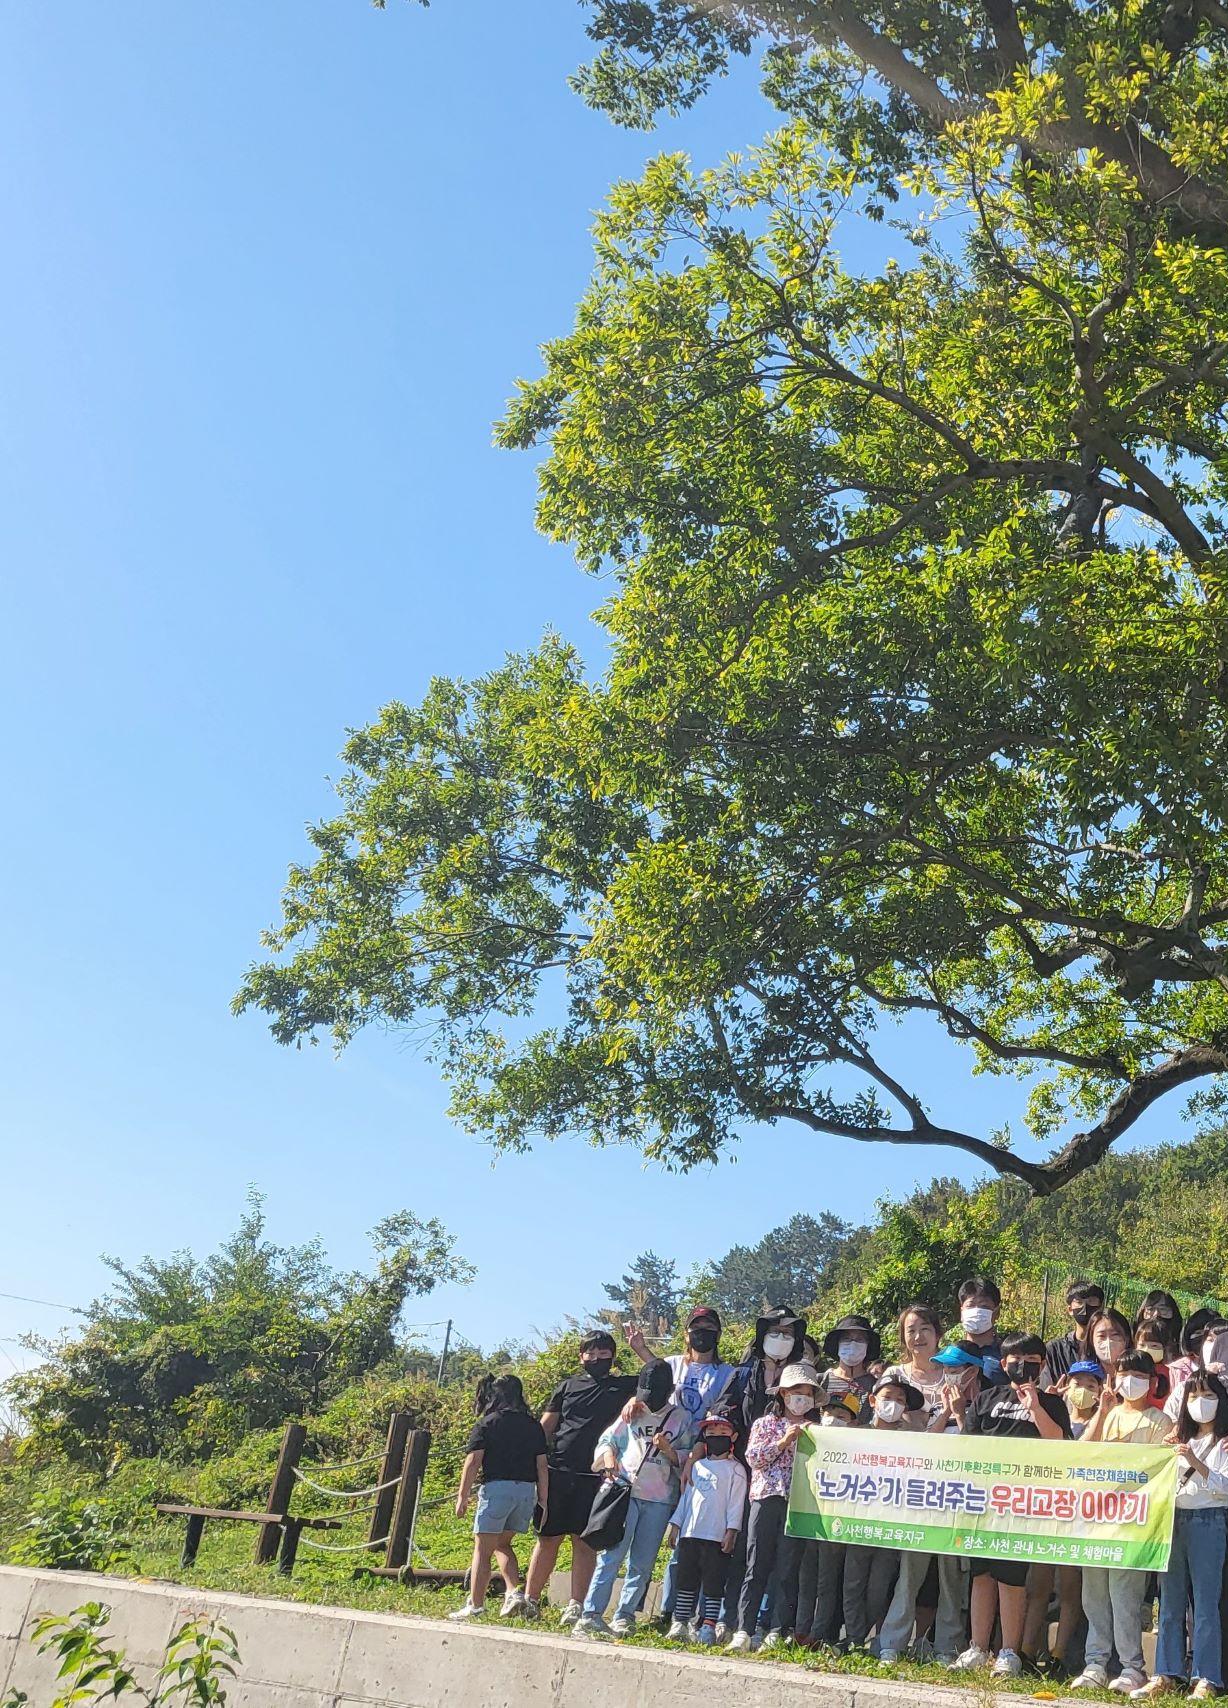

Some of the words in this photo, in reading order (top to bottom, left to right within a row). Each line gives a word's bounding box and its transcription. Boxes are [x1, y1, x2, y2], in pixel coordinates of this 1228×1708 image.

[822, 1450, 850, 1464] 2022.
[852, 1453, 934, 1470] 사천행복교육지구와
[935, 1460, 1021, 1477] 사천기후환경특구가
[1023, 1465, 1063, 1479] 함께하는
[1066, 1467, 1149, 1484] 가족현장체험학습
[906, 1478, 986, 1513] 들려주는
[990, 1485, 1076, 1519] 우리고장
[1081, 1490, 1148, 1524] 이야기
[844, 1524, 925, 1545] 사천행복교육지구
[963, 1535, 987, 1550] 장소:
[990, 1538, 1010, 1552] 사천
[1012, 1540, 1032, 1555] 관내
[1036, 1543, 1067, 1558] 노거수
[1070, 1545, 1080, 1559] 및
[1082, 1545, 1124, 1562] 체험마을
